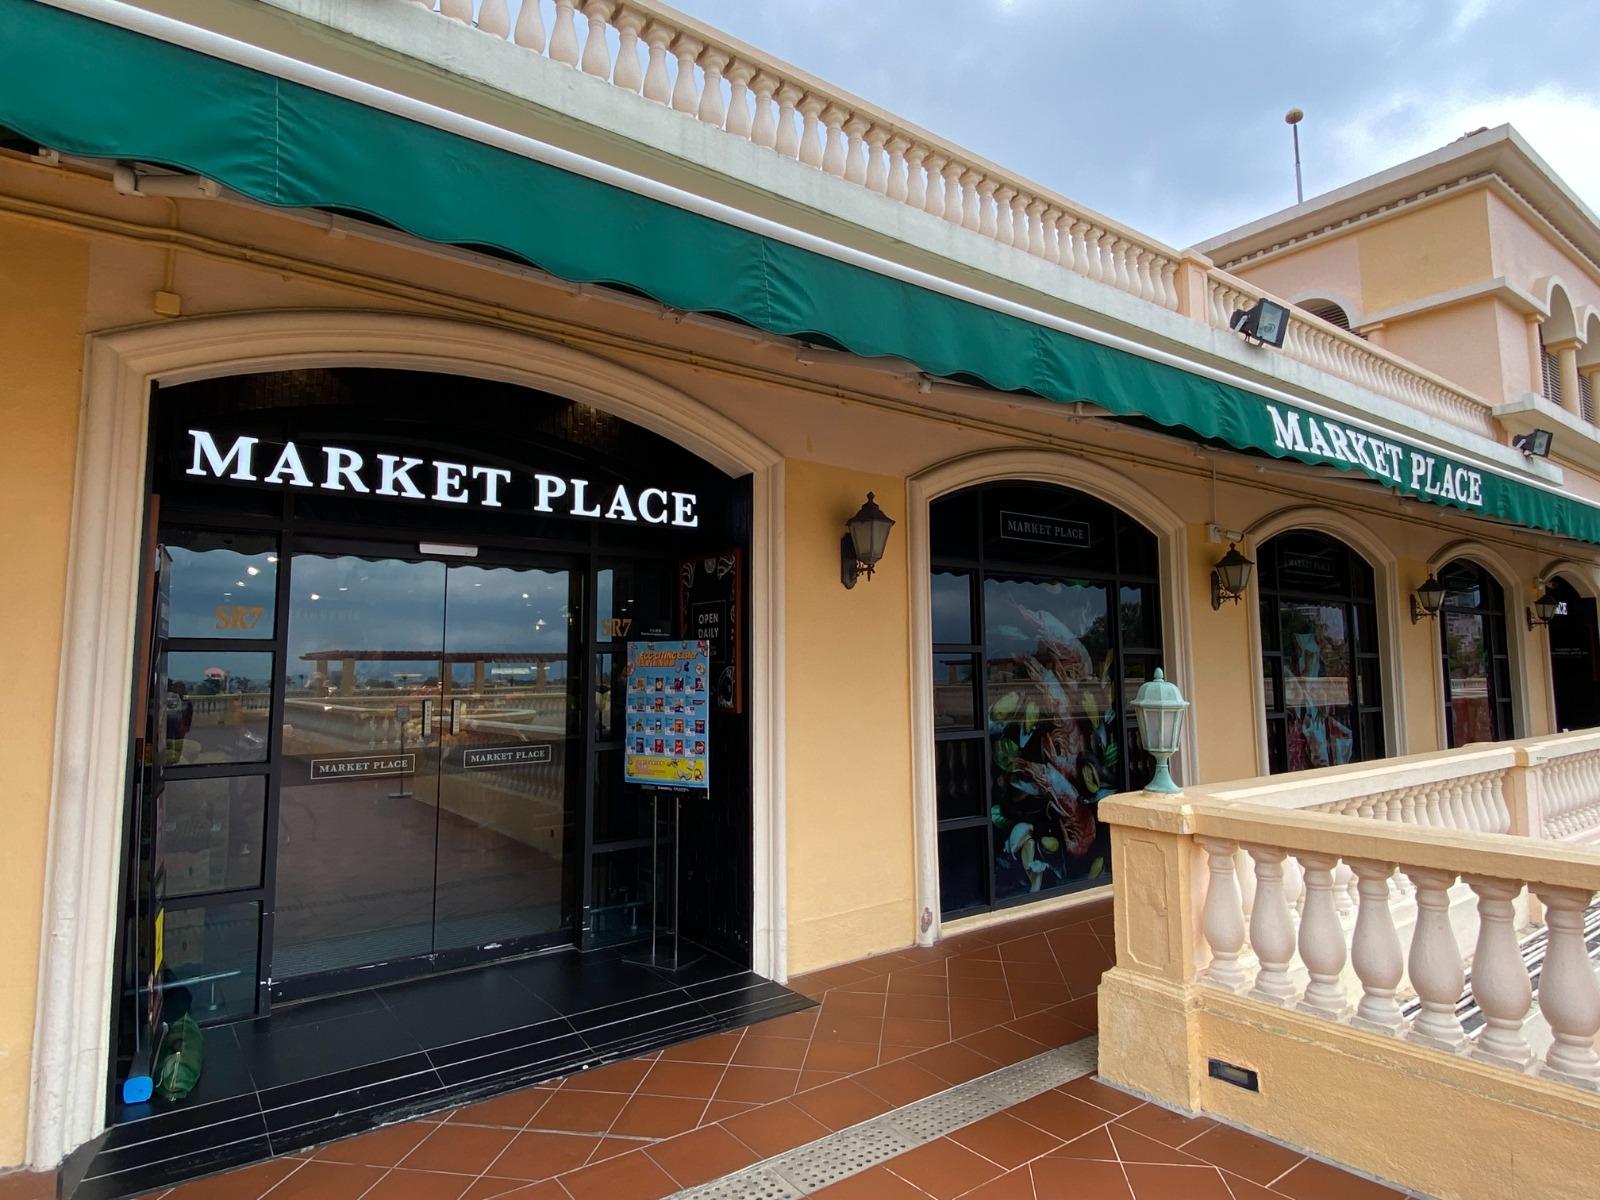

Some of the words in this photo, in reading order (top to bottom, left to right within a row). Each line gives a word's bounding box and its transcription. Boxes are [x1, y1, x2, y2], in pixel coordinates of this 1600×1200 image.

[1266, 405, 1403, 483] MARKET
[1410, 452, 1483, 506] PLACE
[186, 429, 511, 507] MARKET
[533, 474, 698, 527] PLACE
[1008, 520, 1052, 535] MARKET
[1054, 526, 1085, 540] PLACE
[215, 606, 265, 630] SR7
[698, 613, 719, 624] OPEN
[698, 627, 719, 639] DAILY
[471, 752, 513, 762] MARKET
[516, 750, 545, 759] PLACE
[319, 762, 370, 773] MARKET
[373, 760, 408, 769] PLACE
